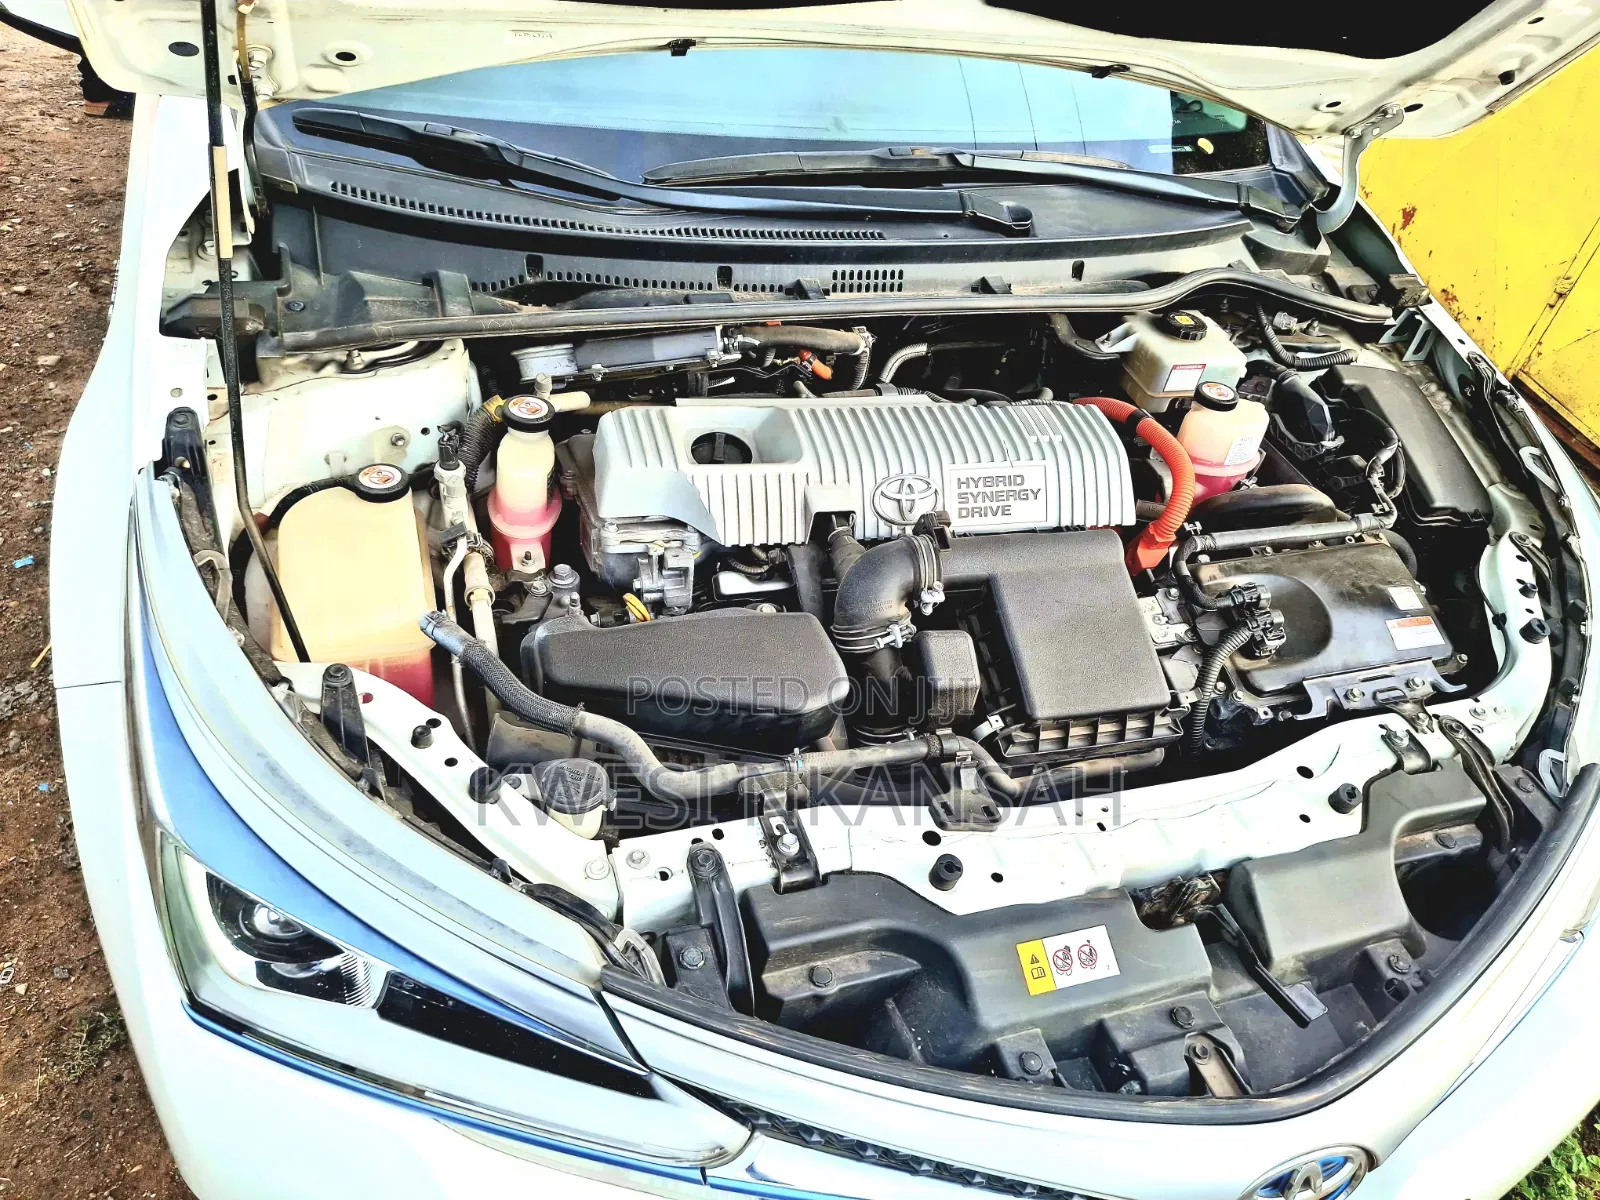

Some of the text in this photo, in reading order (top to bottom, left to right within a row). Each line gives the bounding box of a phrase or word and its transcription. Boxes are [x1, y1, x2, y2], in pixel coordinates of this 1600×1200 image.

[957, 474, 1025, 489] HYBRID
[957, 488, 1042, 504] SYNERGY
[957, 504, 1012, 519] DRIVE
